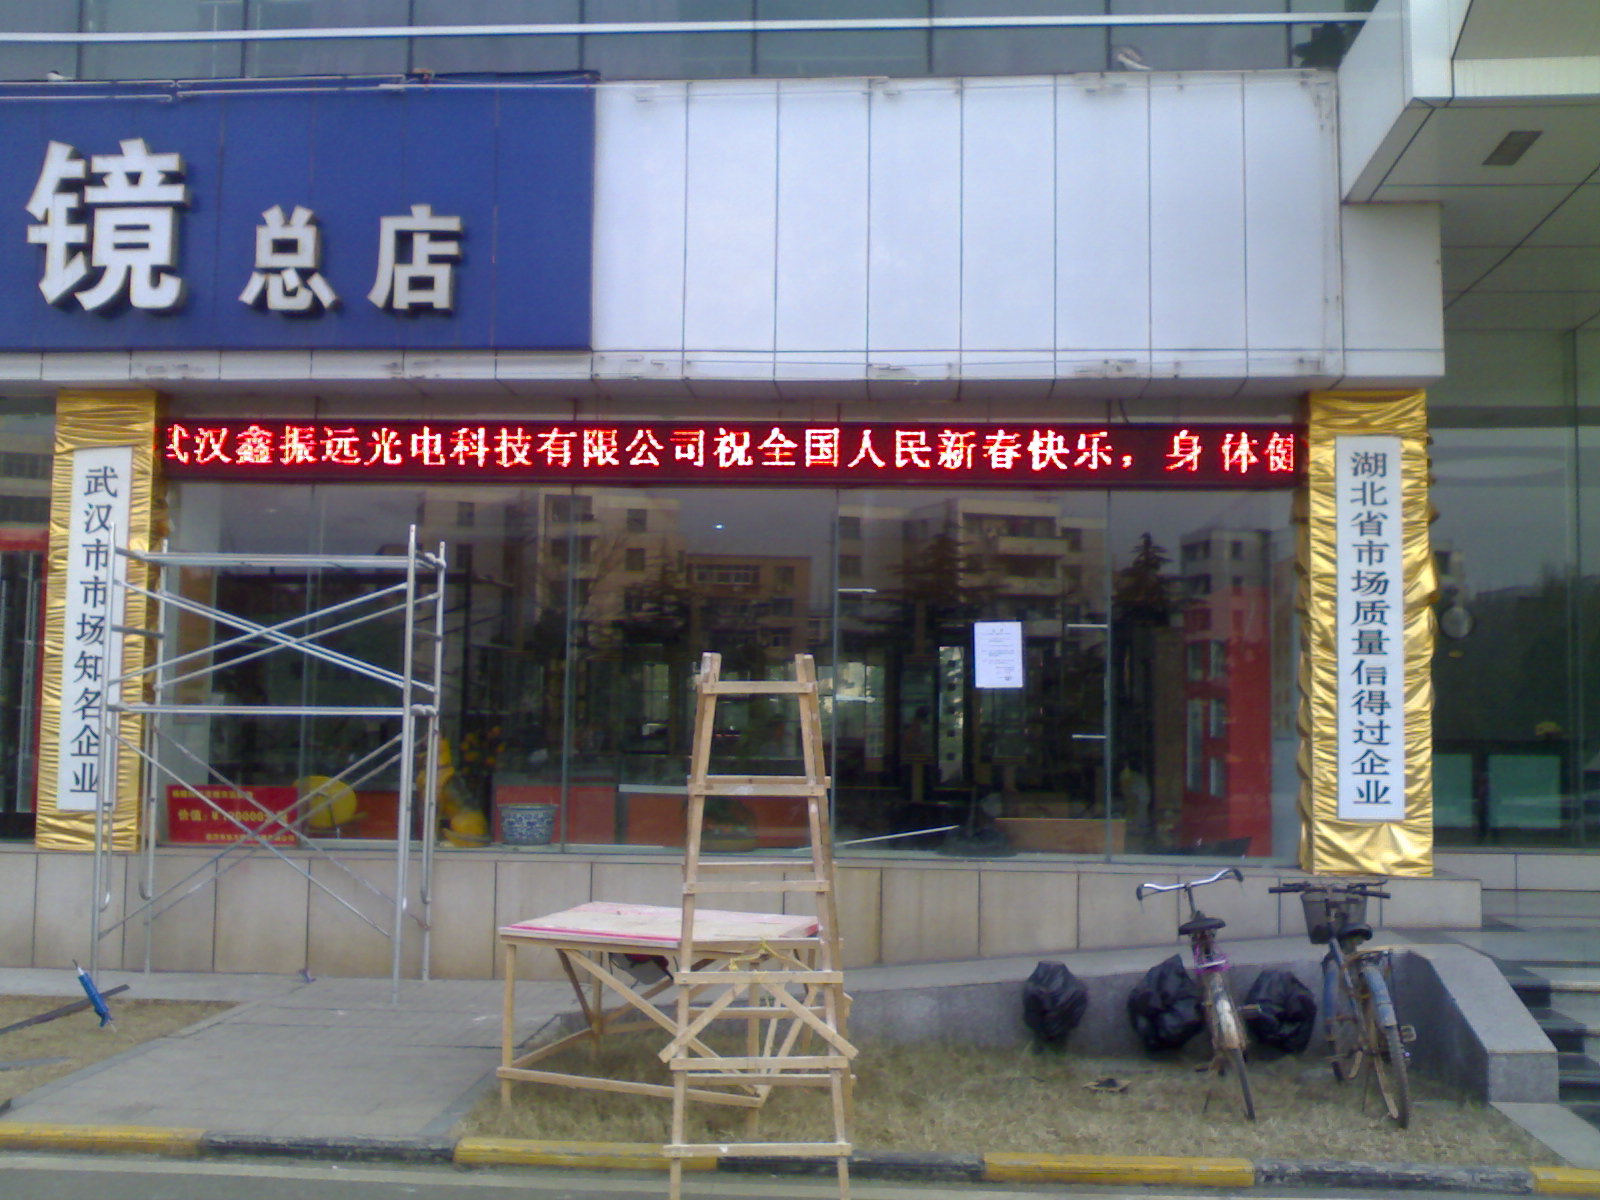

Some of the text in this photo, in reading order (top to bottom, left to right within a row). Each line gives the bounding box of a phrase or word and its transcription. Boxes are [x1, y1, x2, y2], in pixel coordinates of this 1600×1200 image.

[26, 138, 464, 312] 镜 总店
[69, 465, 119, 793] 武汉市市场知名企业
[1350, 451, 1391, 806] 湖北省市场质量信得过企业
